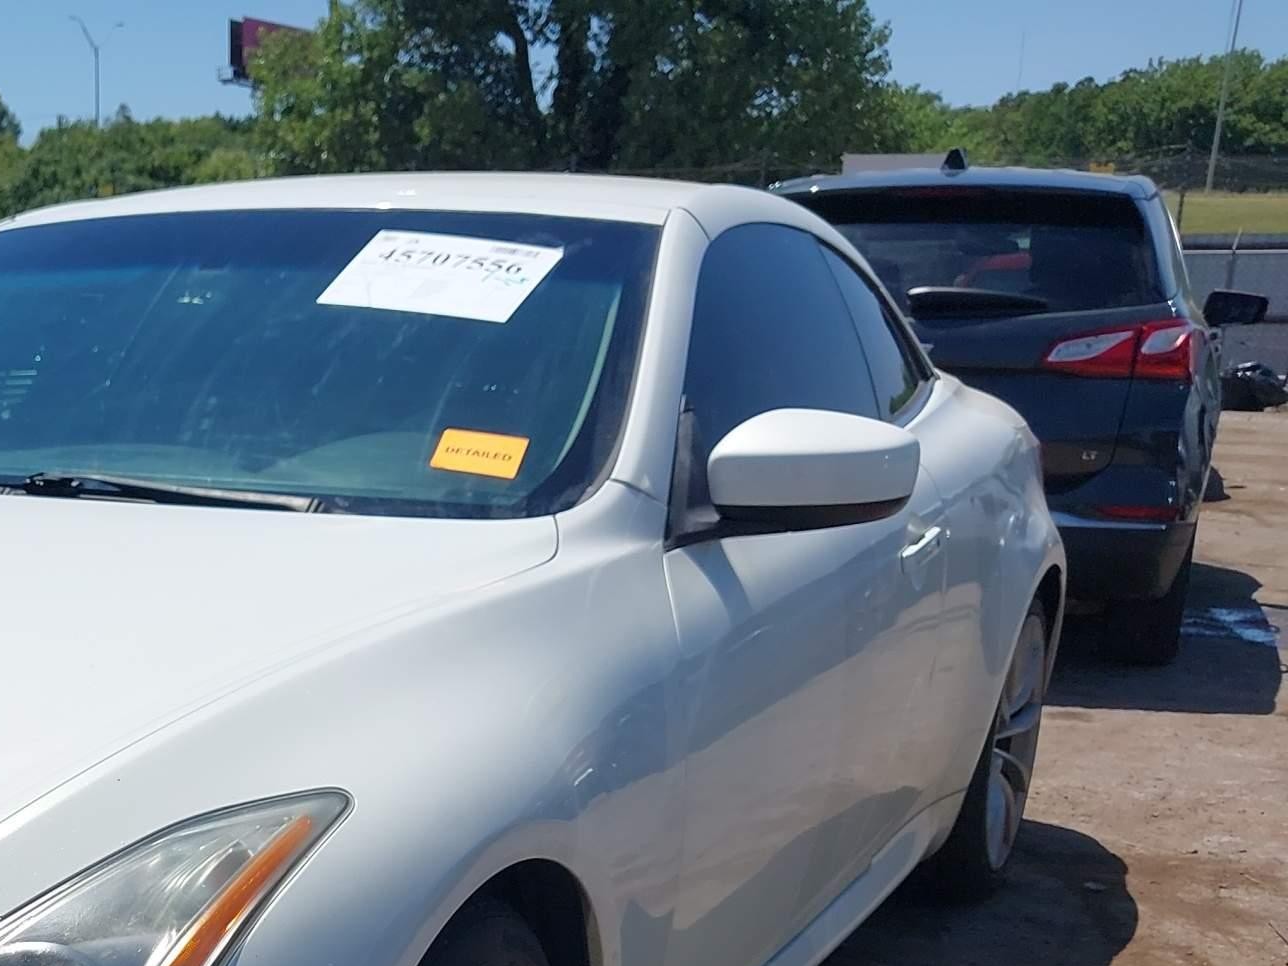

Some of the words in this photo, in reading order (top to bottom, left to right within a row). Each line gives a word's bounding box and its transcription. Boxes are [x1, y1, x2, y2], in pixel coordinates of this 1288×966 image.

[378, 247, 523, 275] 45707556
[445, 445, 513, 462] DETAILED
[1081, 450, 1098, 461] LT
